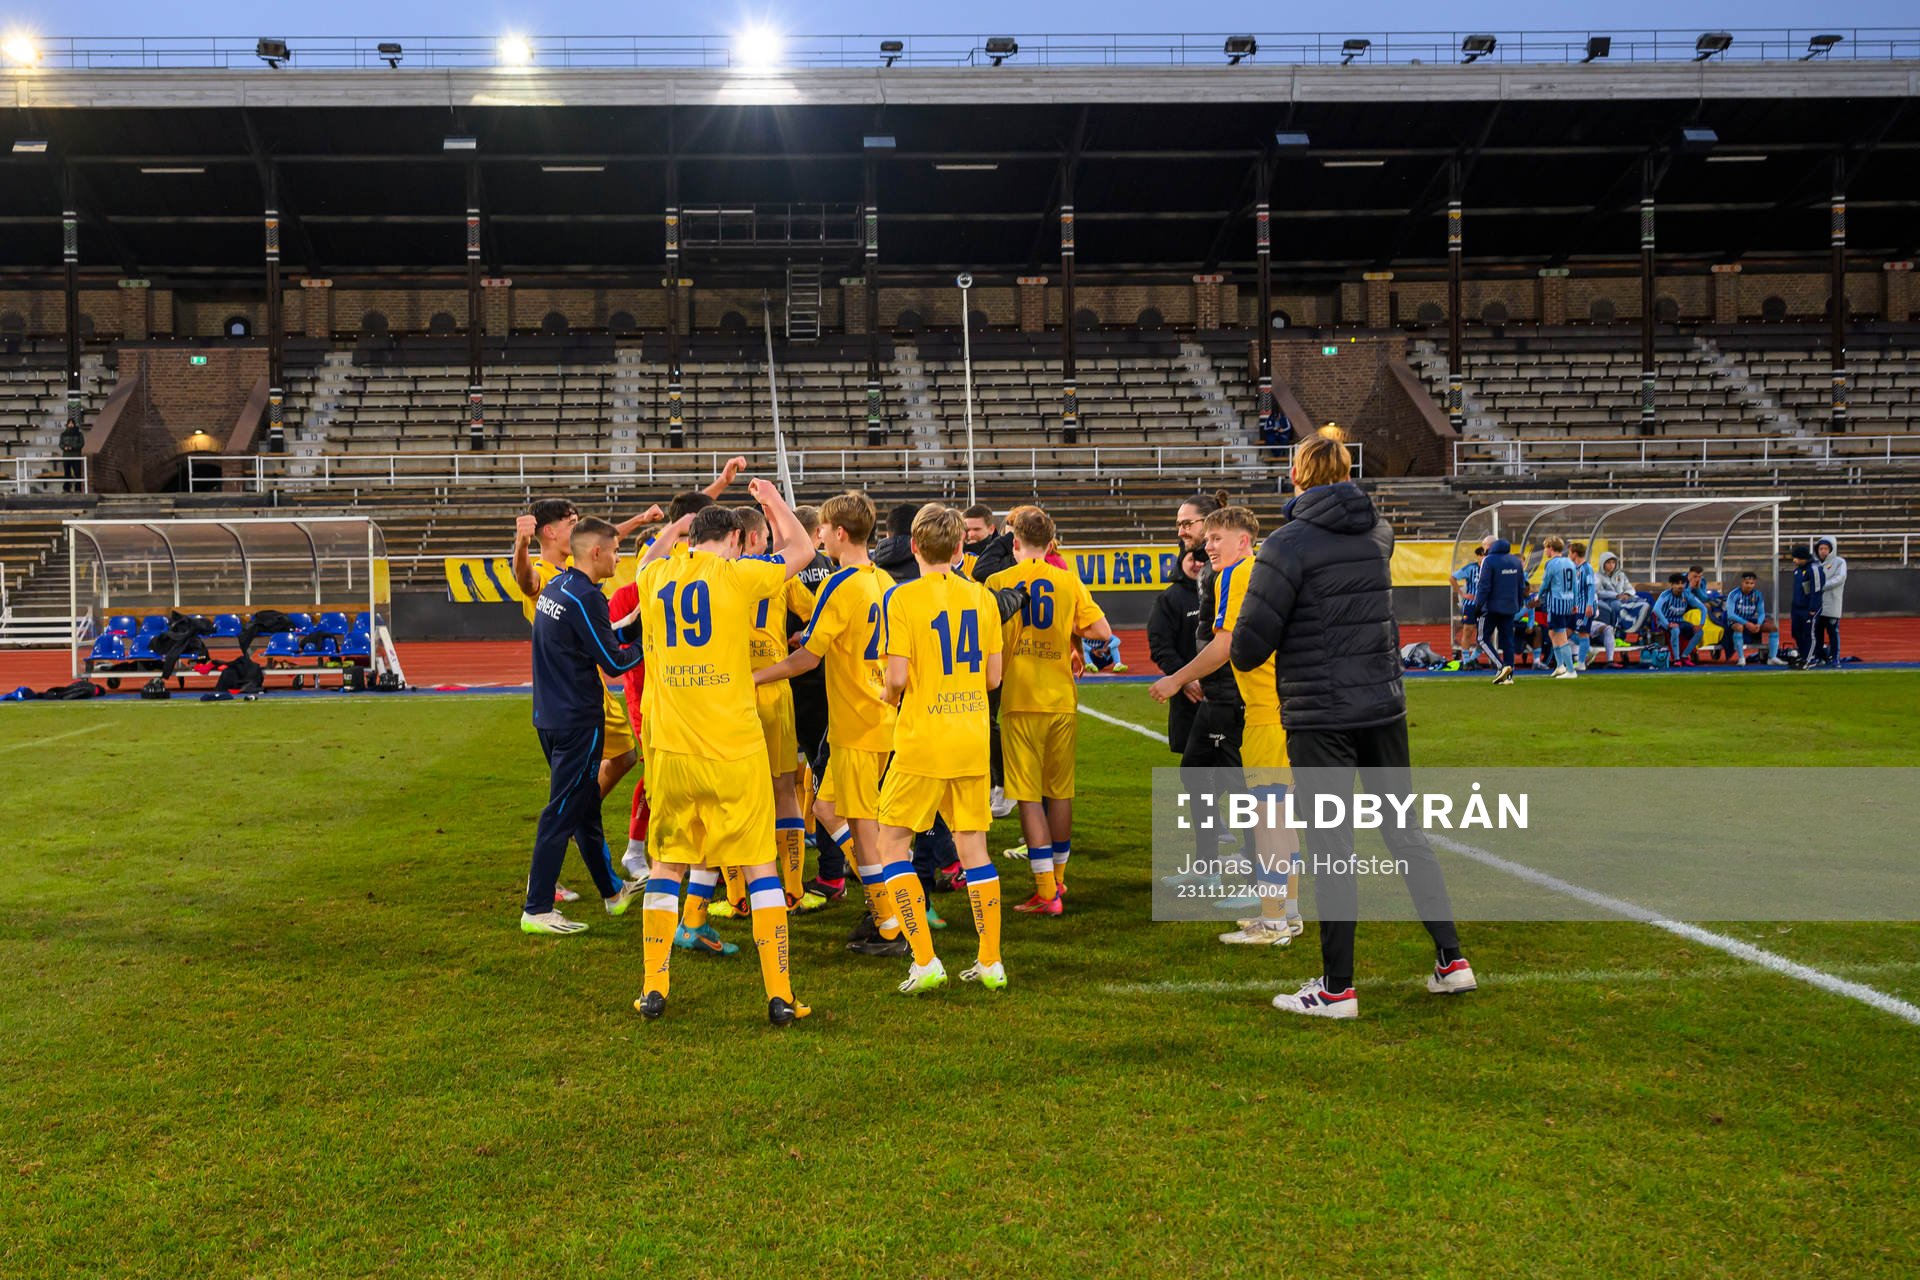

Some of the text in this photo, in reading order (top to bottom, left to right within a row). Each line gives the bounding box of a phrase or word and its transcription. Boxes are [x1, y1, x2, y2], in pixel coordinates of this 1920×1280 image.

[1075, 554, 1106, 585] VI
[1113, 552, 1153, 584] ÄR
[1562, 568, 1573, 592] 19
[657, 580, 712, 648] 19
[931, 609, 982, 675] 14
[1018, 639, 1051, 650] NDIC
[1013, 647, 1062, 660] WELESS
[666, 664, 714, 675] NORDIC
[937, 690, 982, 703] NORDIC
[928, 701, 986, 714] WELLNES
